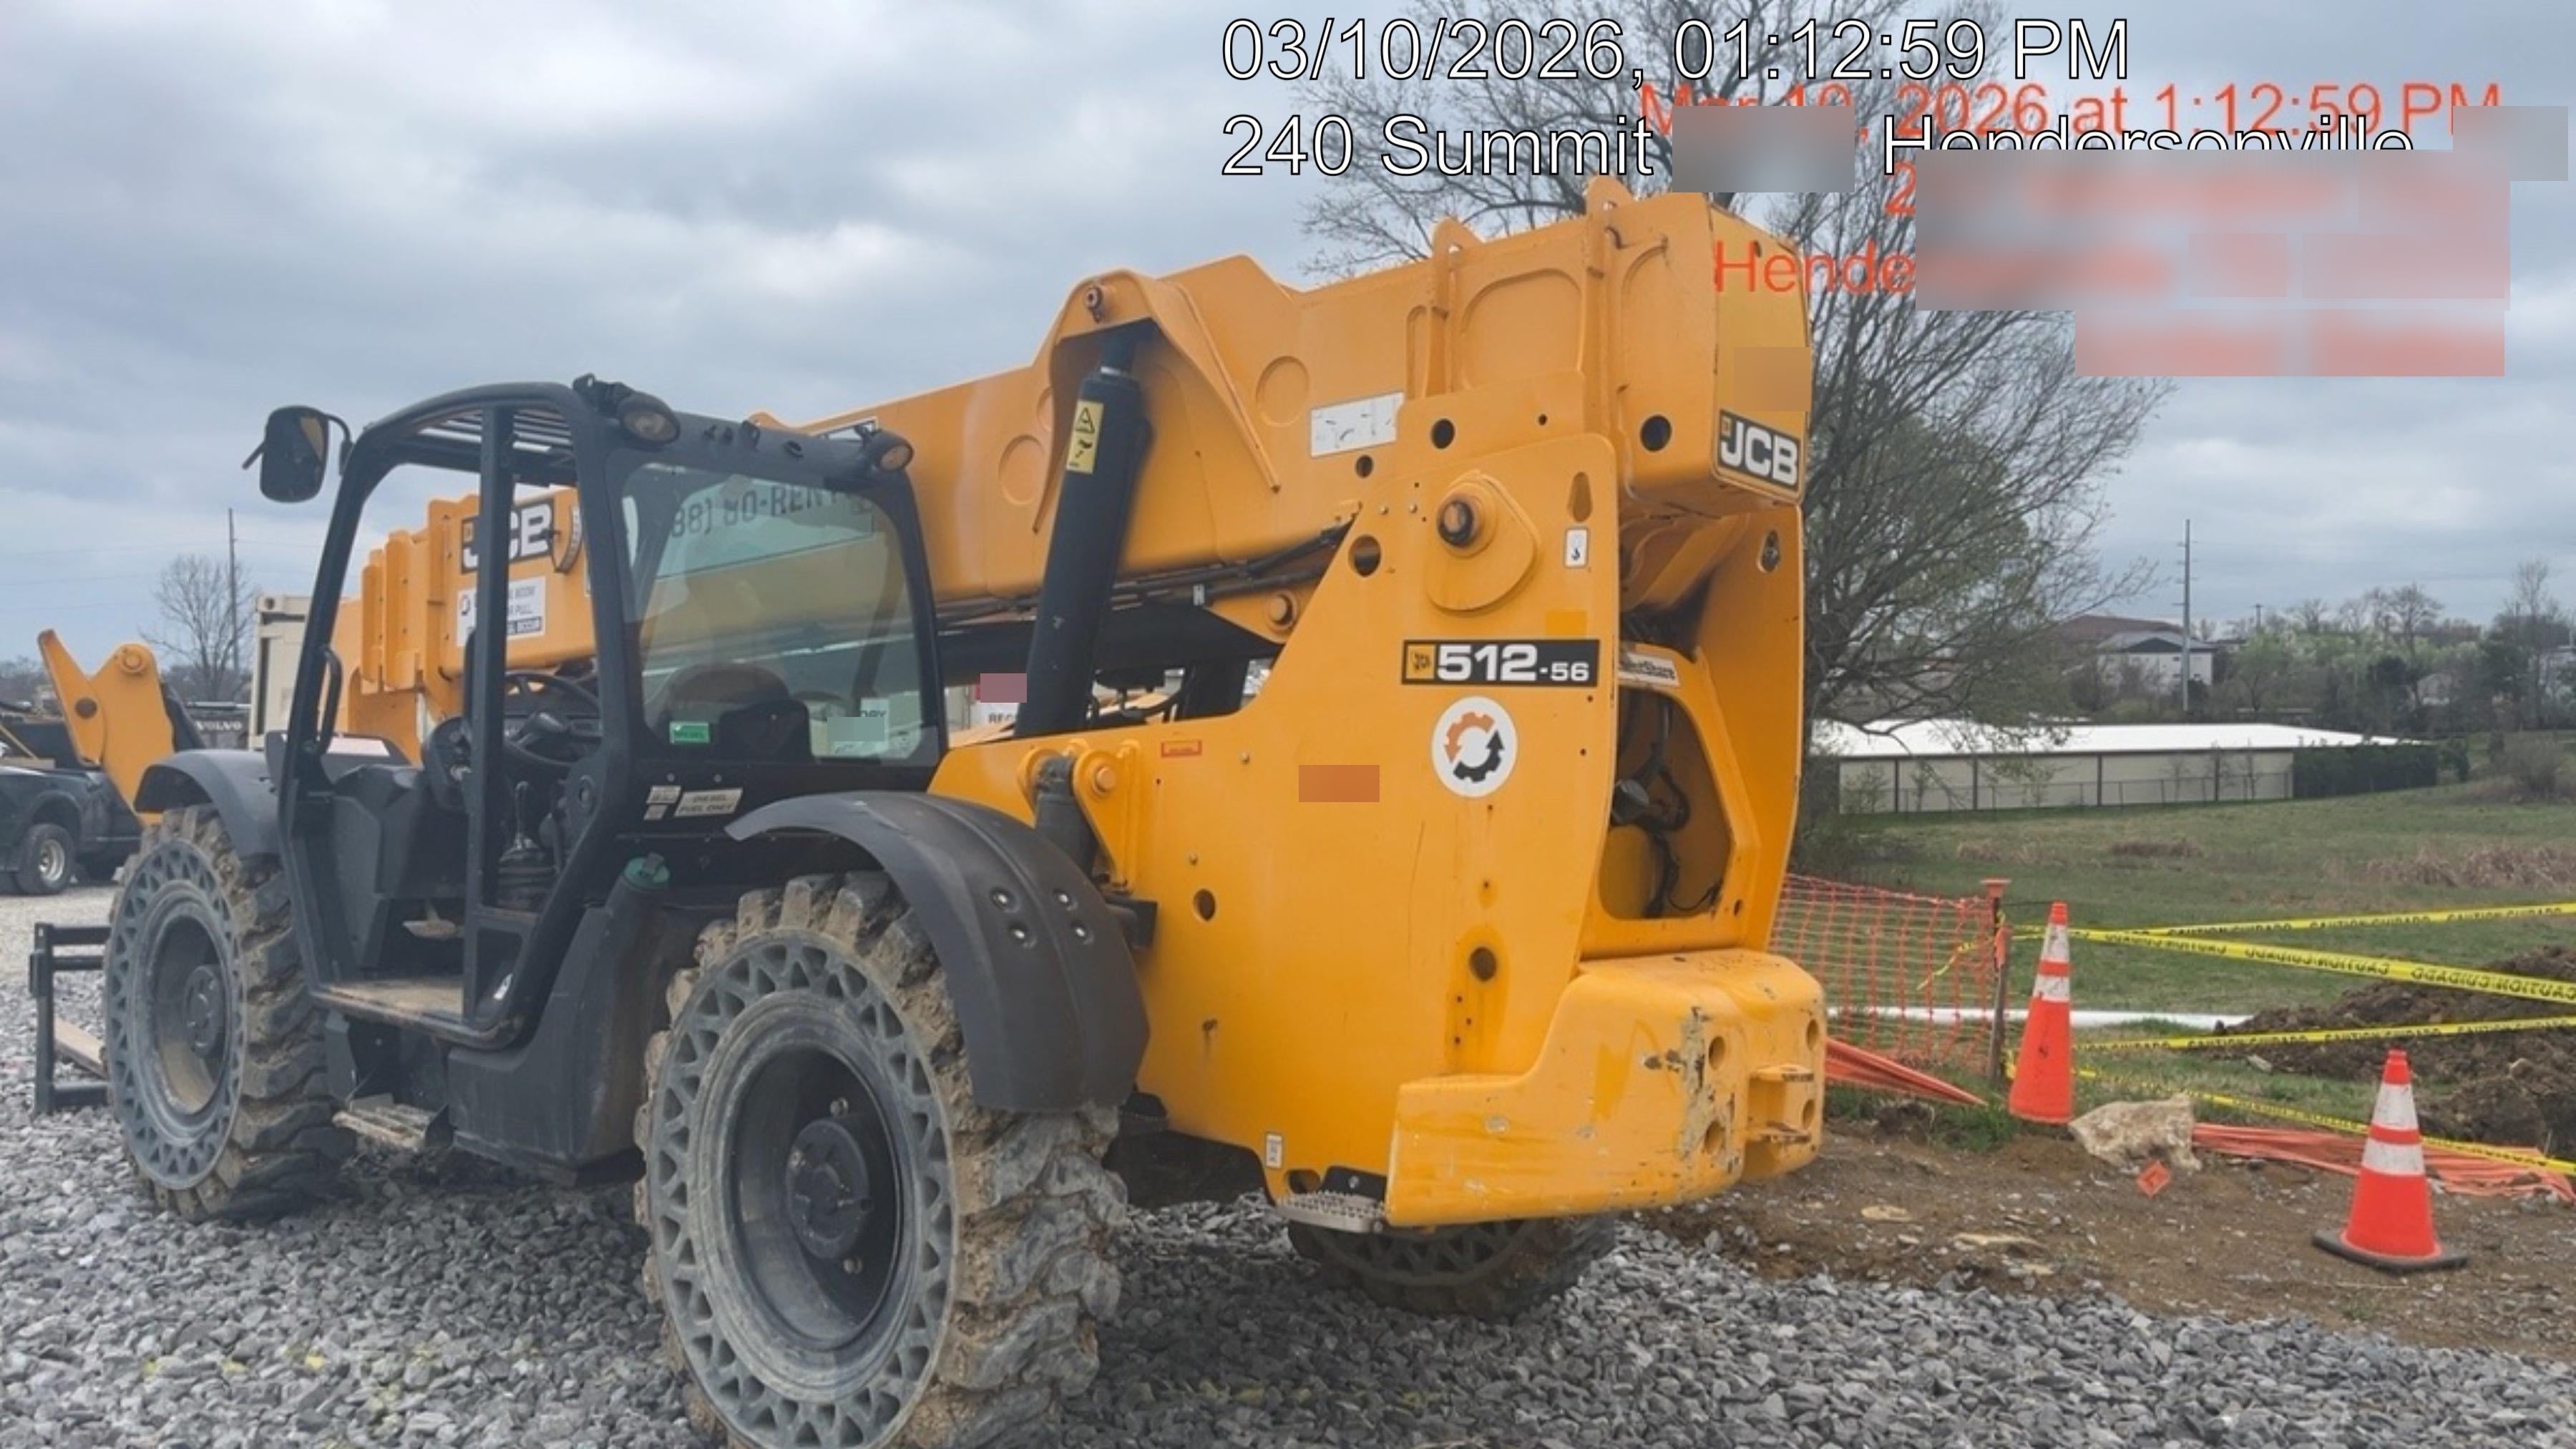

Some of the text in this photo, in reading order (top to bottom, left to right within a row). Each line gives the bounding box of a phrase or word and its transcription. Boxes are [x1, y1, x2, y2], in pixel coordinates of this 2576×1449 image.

[1720, 420, 1798, 486] JCB
[1437, 643, 1590, 682] 512-56
[195, 720, 243, 731] VOLVO
